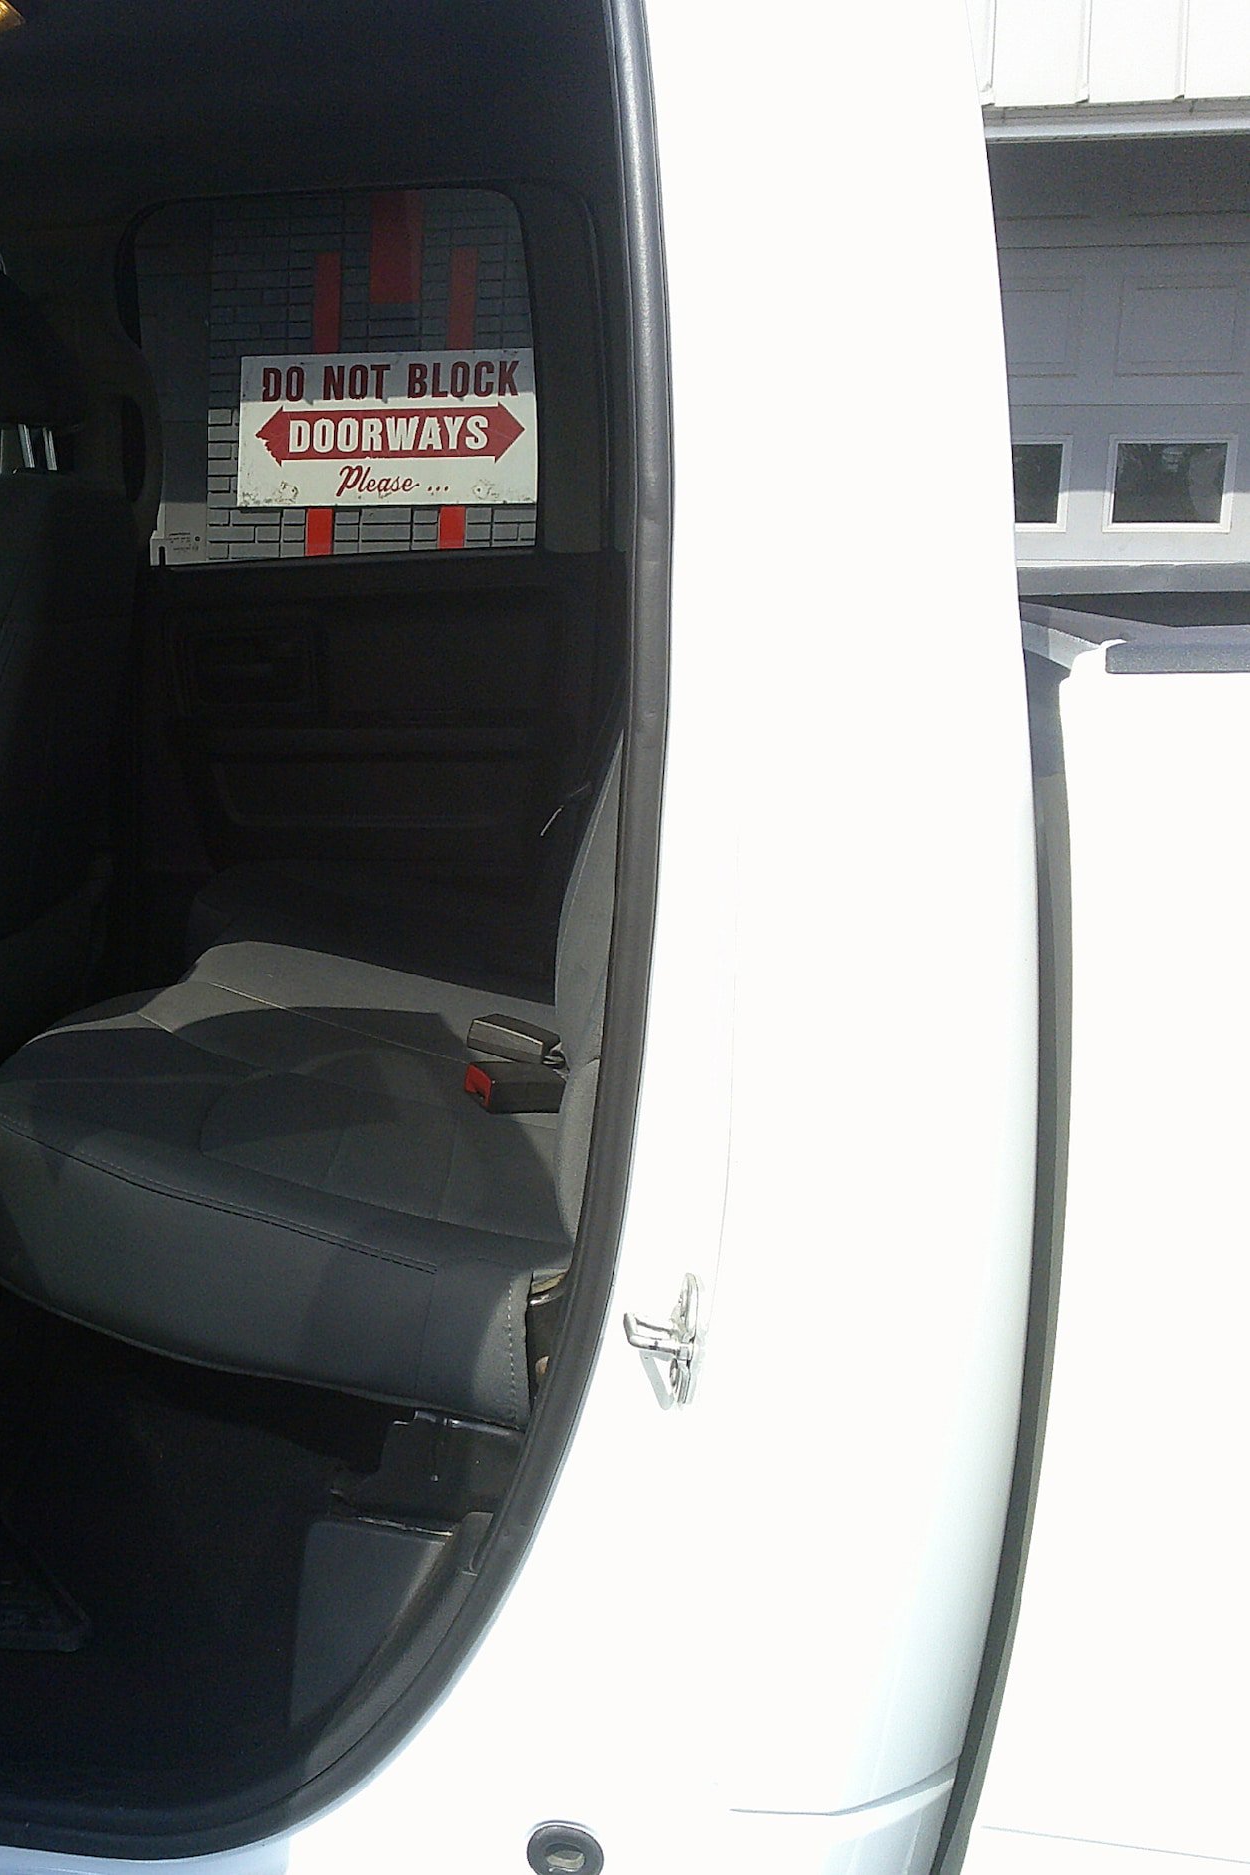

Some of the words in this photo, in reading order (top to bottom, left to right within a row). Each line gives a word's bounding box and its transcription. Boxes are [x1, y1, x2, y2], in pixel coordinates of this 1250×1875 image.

[261, 365, 305, 403] DO
[322, 364, 391, 401] NOT
[407, 360, 520, 399] BLOCK
[288, 415, 490, 453] DOORWAYS
[335, 465, 420, 497] Please
